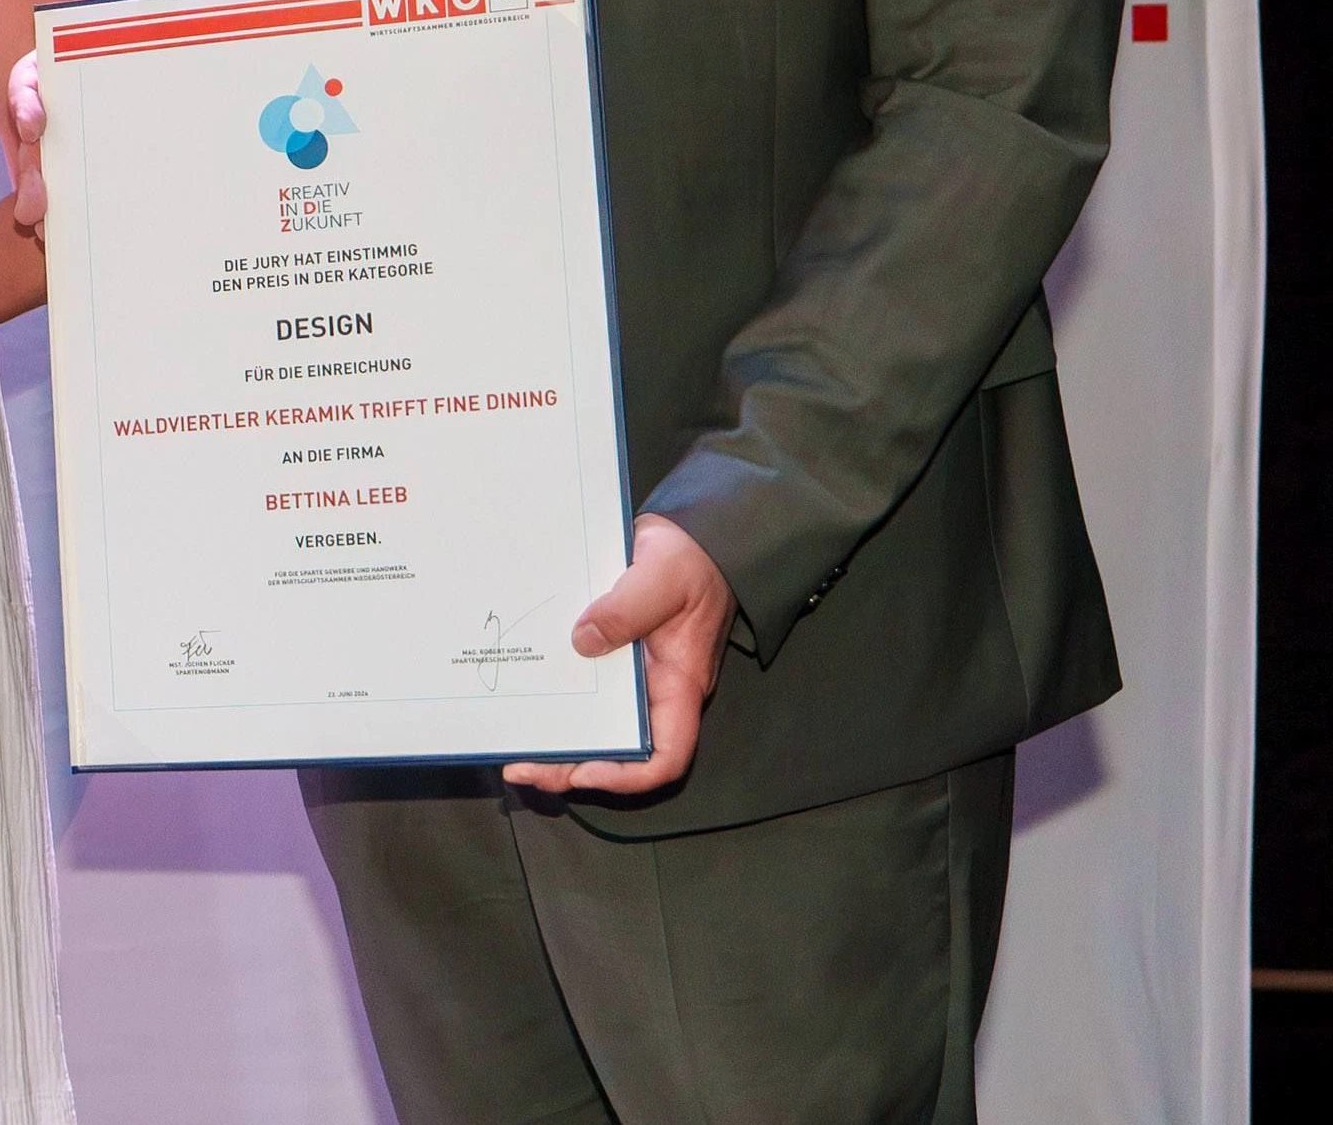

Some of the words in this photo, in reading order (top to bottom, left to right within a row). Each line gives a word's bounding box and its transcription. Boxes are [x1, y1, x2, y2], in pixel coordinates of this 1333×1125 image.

[370, 22, 453, 37] WIRTSCHAFTSKAMMER
[279, 182, 350, 202] KREATIV
[280, 202, 298, 217] IN
[304, 199, 332, 215] DIE
[281, 212, 363, 232] ZUKUNFT
[224, 258, 248, 273] DIE
[252, 254, 289, 270] JURY
[294, 252, 322, 266] HAT
[327, 243, 418, 264] EINSTIMMIG
[212, 278, 242, 293] DEN
[247, 274, 290, 290] PREIS
[294, 272, 309, 286] IN
[314, 270, 344, 284] DER
[349, 262, 434, 281] KATEGORIE
[276, 312, 374, 341] DESIGN
[245, 366, 274, 382] FÜR
[279, 366, 303, 380] DIE
[308, 358, 412, 378] EINREICHUNG
[114, 411, 260, 437] WALDVIERTLER
[265, 404, 355, 426] KERAMIK
[360, 398, 428, 420] TRIFFT
[434, 394, 481, 415] FINE
[486, 389, 559, 411] DINING
[282, 450, 303, 465] AN
[307, 448, 332, 463] DIE
[337, 445, 385, 461] FIRMA
[265, 489, 351, 512] BETTINA
[357, 486, 408, 506] LEEB
[295, 531, 383, 549] VERGEBEN.
